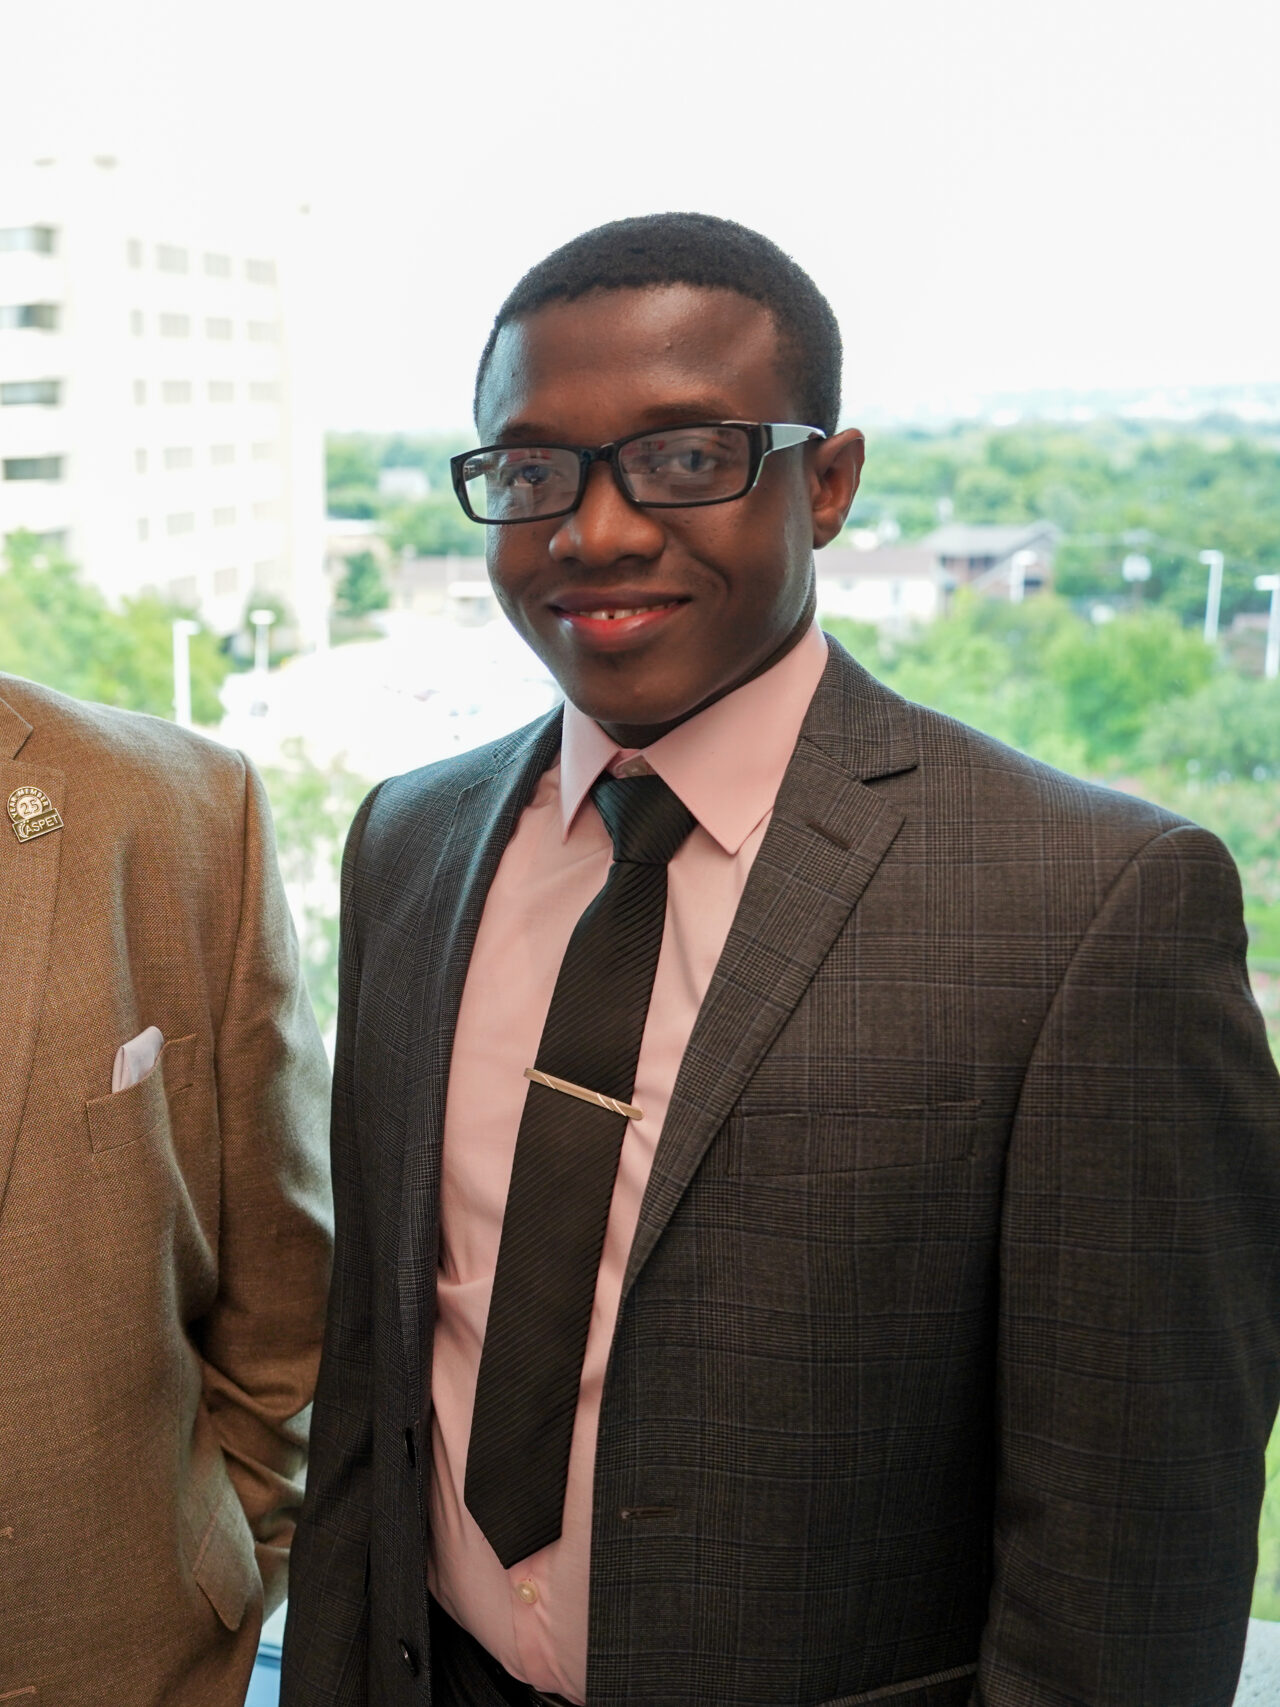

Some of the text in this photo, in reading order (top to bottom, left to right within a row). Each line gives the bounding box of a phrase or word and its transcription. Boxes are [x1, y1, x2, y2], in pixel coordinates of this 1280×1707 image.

[9, 788, 49, 817] YEAR MEMBER
[20, 799, 40, 815] 25
[26, 814, 59, 836] ASPET
